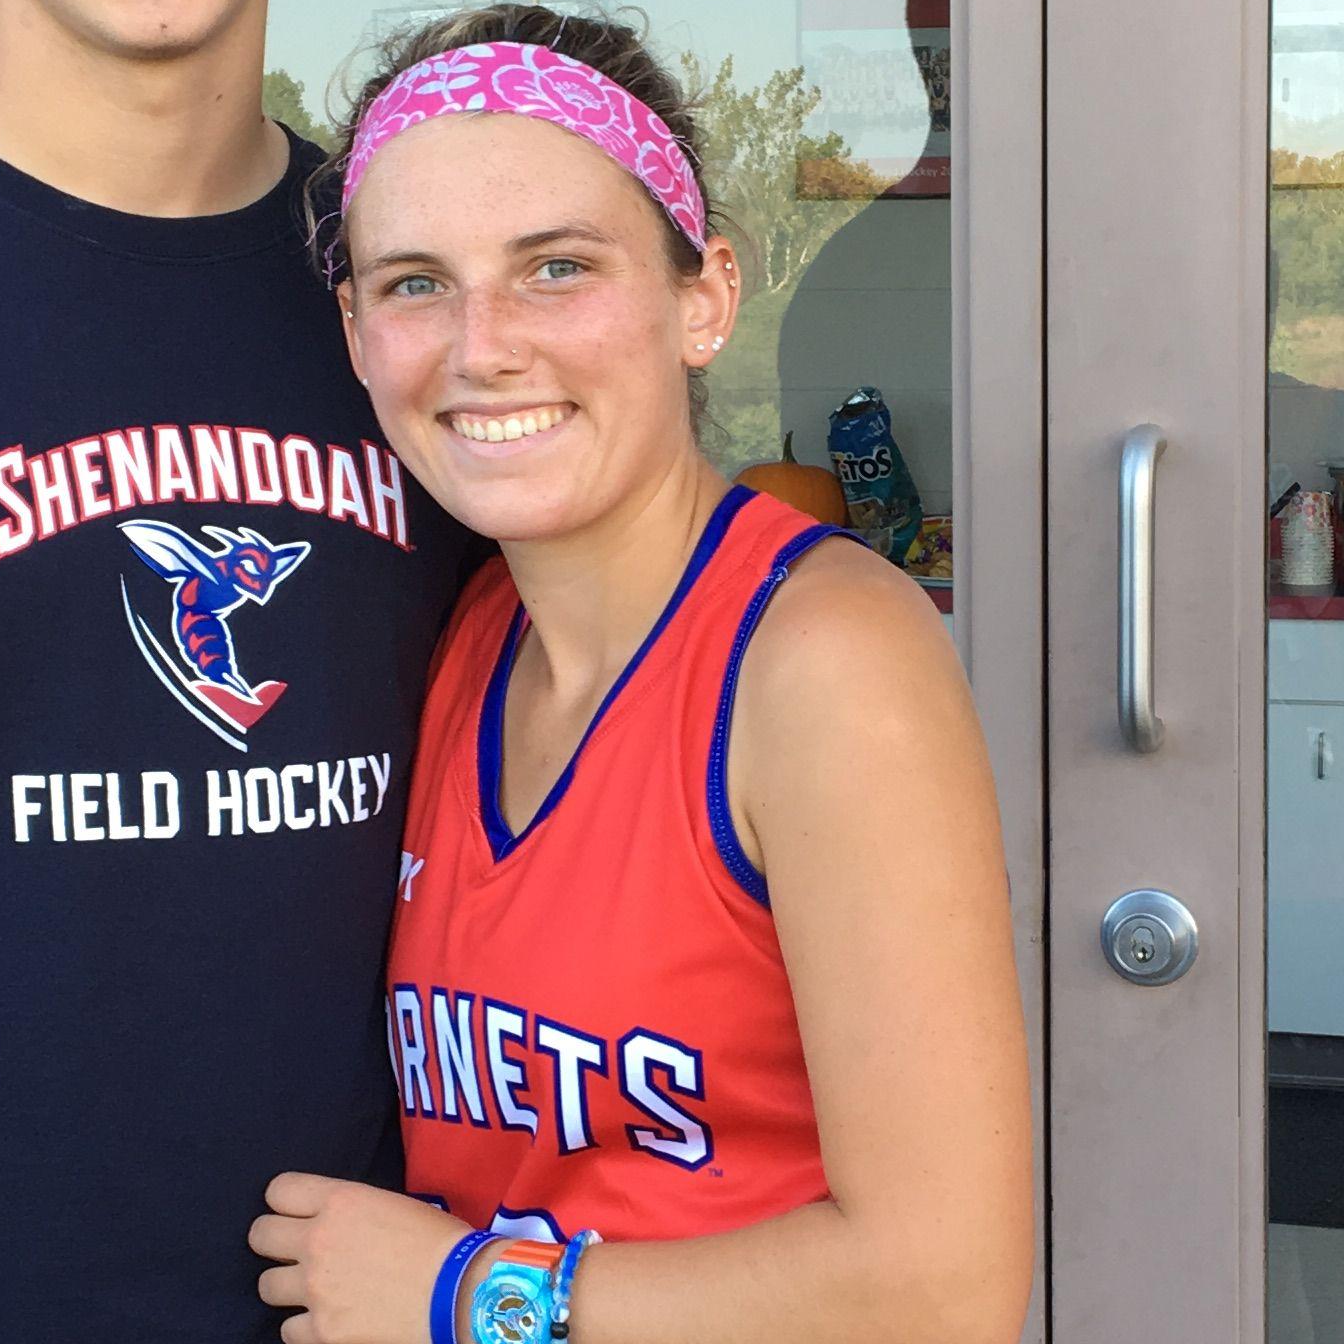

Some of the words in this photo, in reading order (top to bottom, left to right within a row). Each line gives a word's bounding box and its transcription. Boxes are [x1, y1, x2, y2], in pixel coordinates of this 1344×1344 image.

[11, 771, 181, 842] FIELD
[207, 752, 391, 836] HOCKEY
[386, 982, 714, 1173] RNETS
